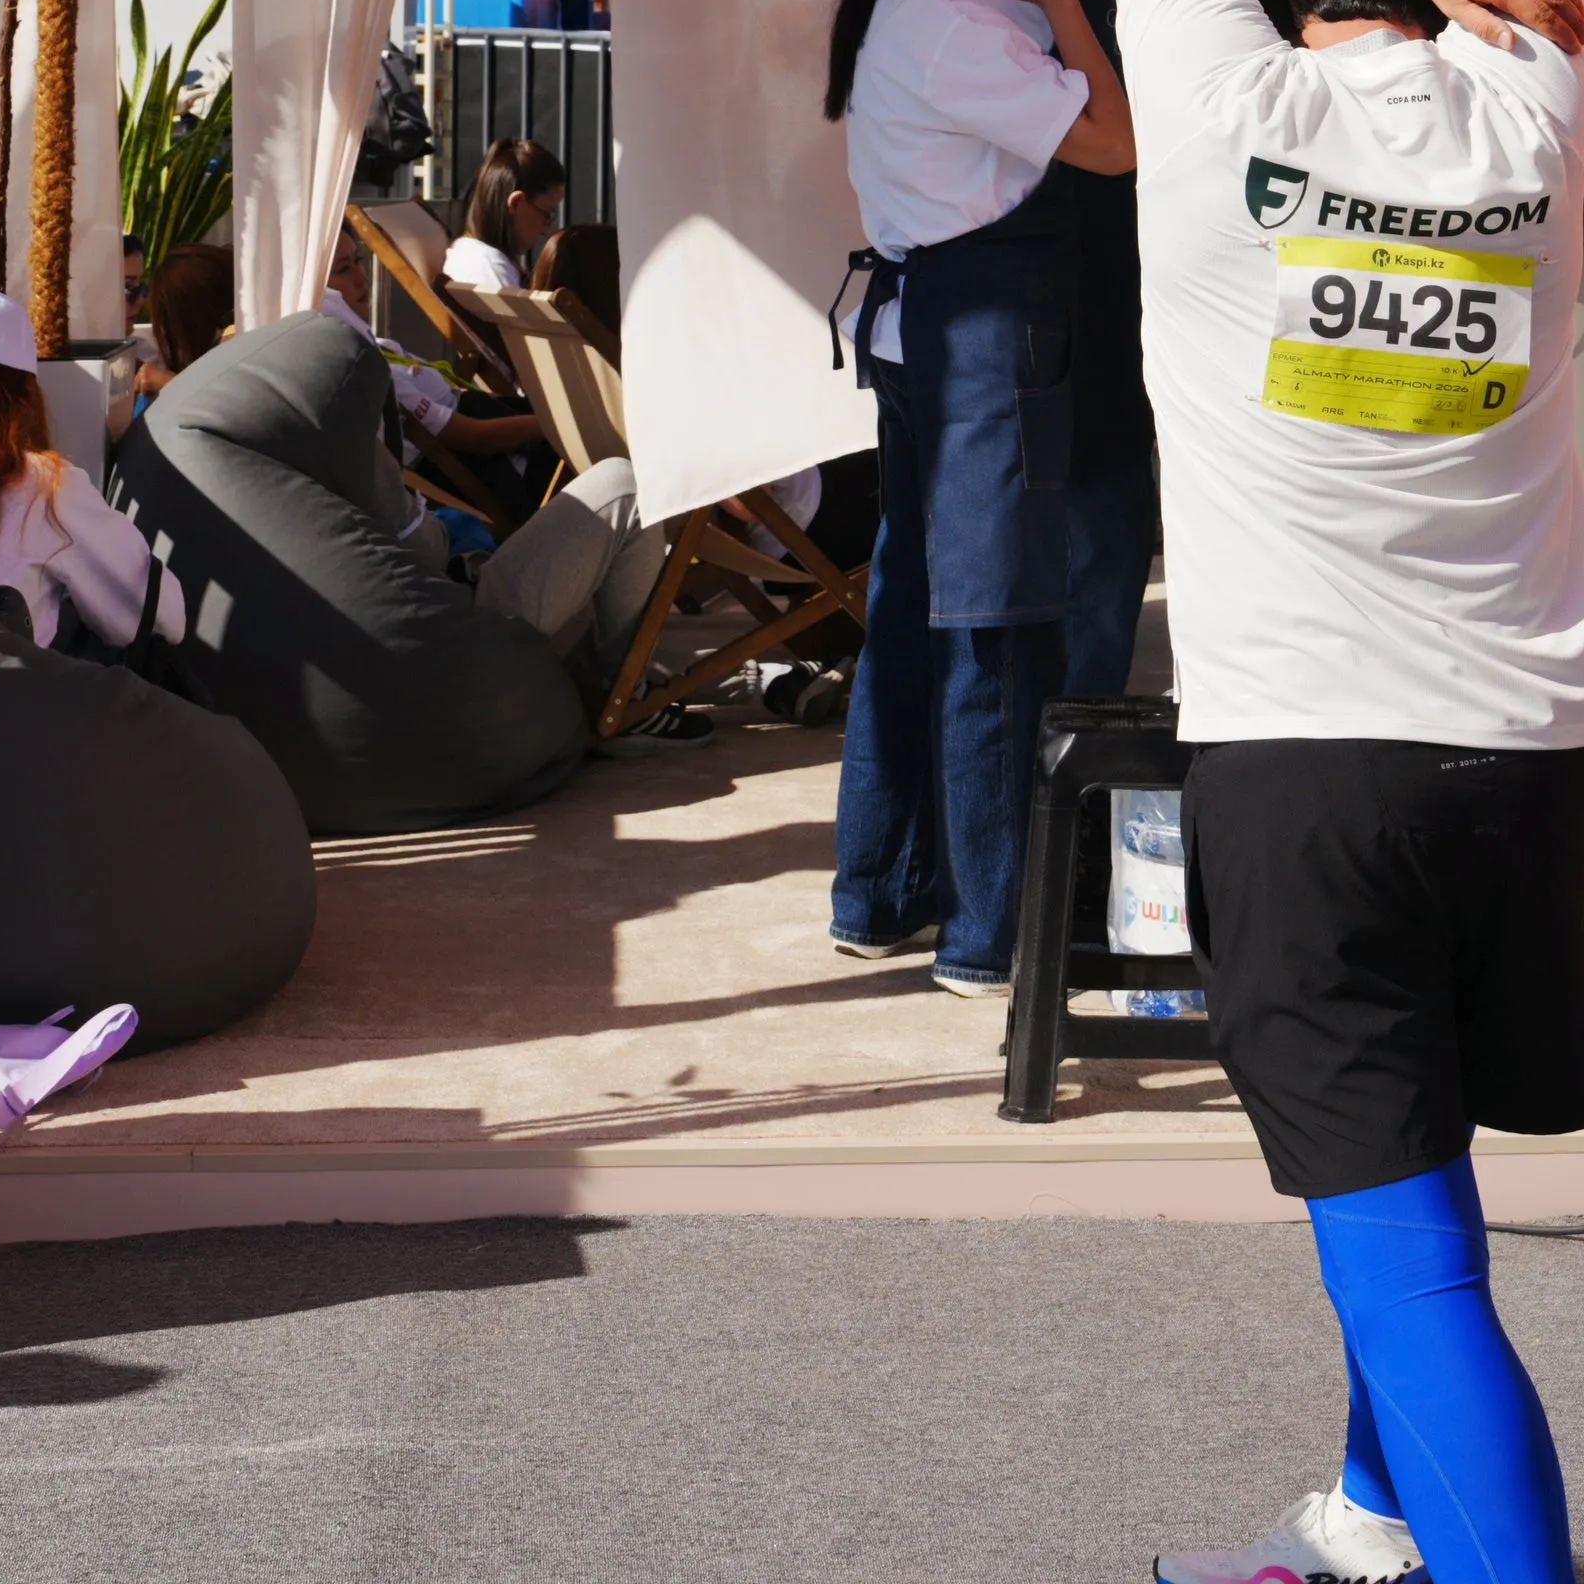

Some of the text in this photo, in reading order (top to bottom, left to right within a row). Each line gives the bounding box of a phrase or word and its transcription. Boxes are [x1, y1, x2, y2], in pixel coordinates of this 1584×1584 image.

[1411, 94, 1431, 103] RUN
[1317, 190, 1551, 238] FREEDOM
[1394, 254, 1445, 270] Kaspi.kz
[1309, 274, 1497, 354] 9425
[1293, 368, 1350, 381] ALMATY
[1353, 375, 1432, 390] MARATHON
[1483, 381, 1506, 410] D
